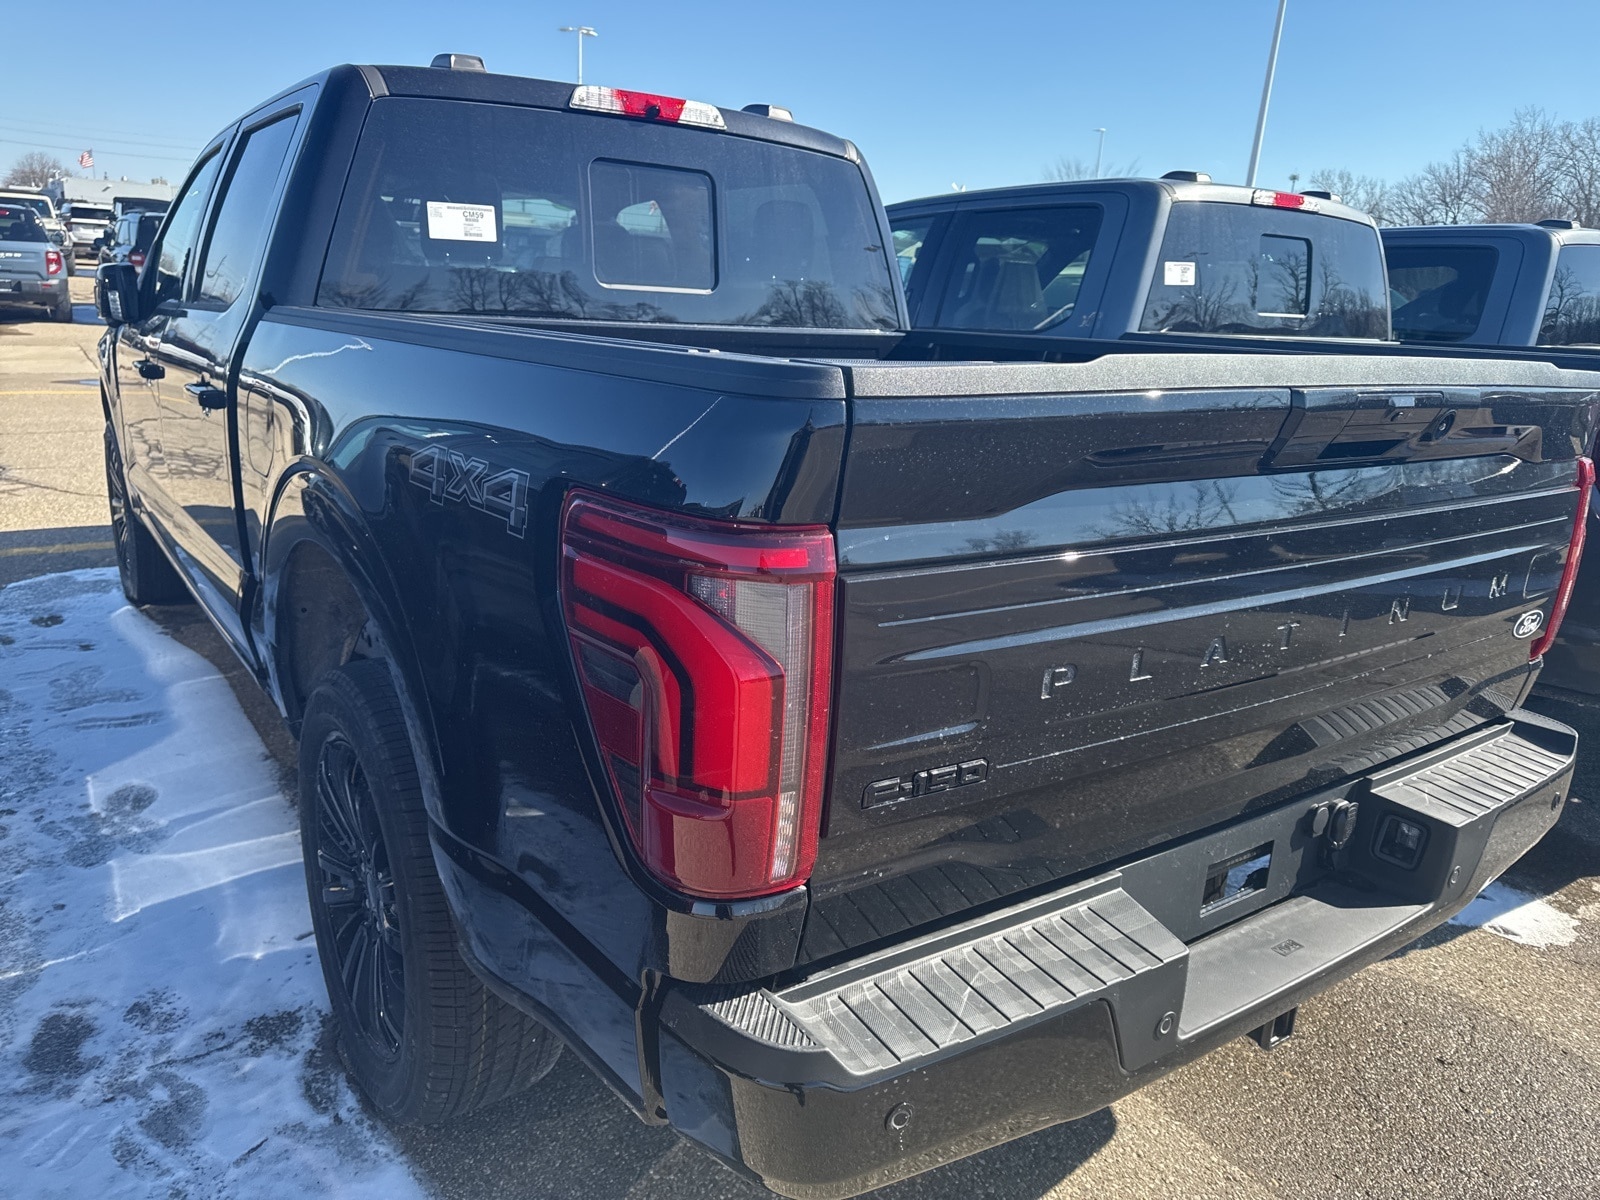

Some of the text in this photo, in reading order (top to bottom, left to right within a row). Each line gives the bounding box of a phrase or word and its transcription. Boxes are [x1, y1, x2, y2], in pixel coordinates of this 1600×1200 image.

[462, 210, 485, 219] CM59
[1040, 573, 1509, 700] PLATINUM
[861, 757, 989, 809] F-150
